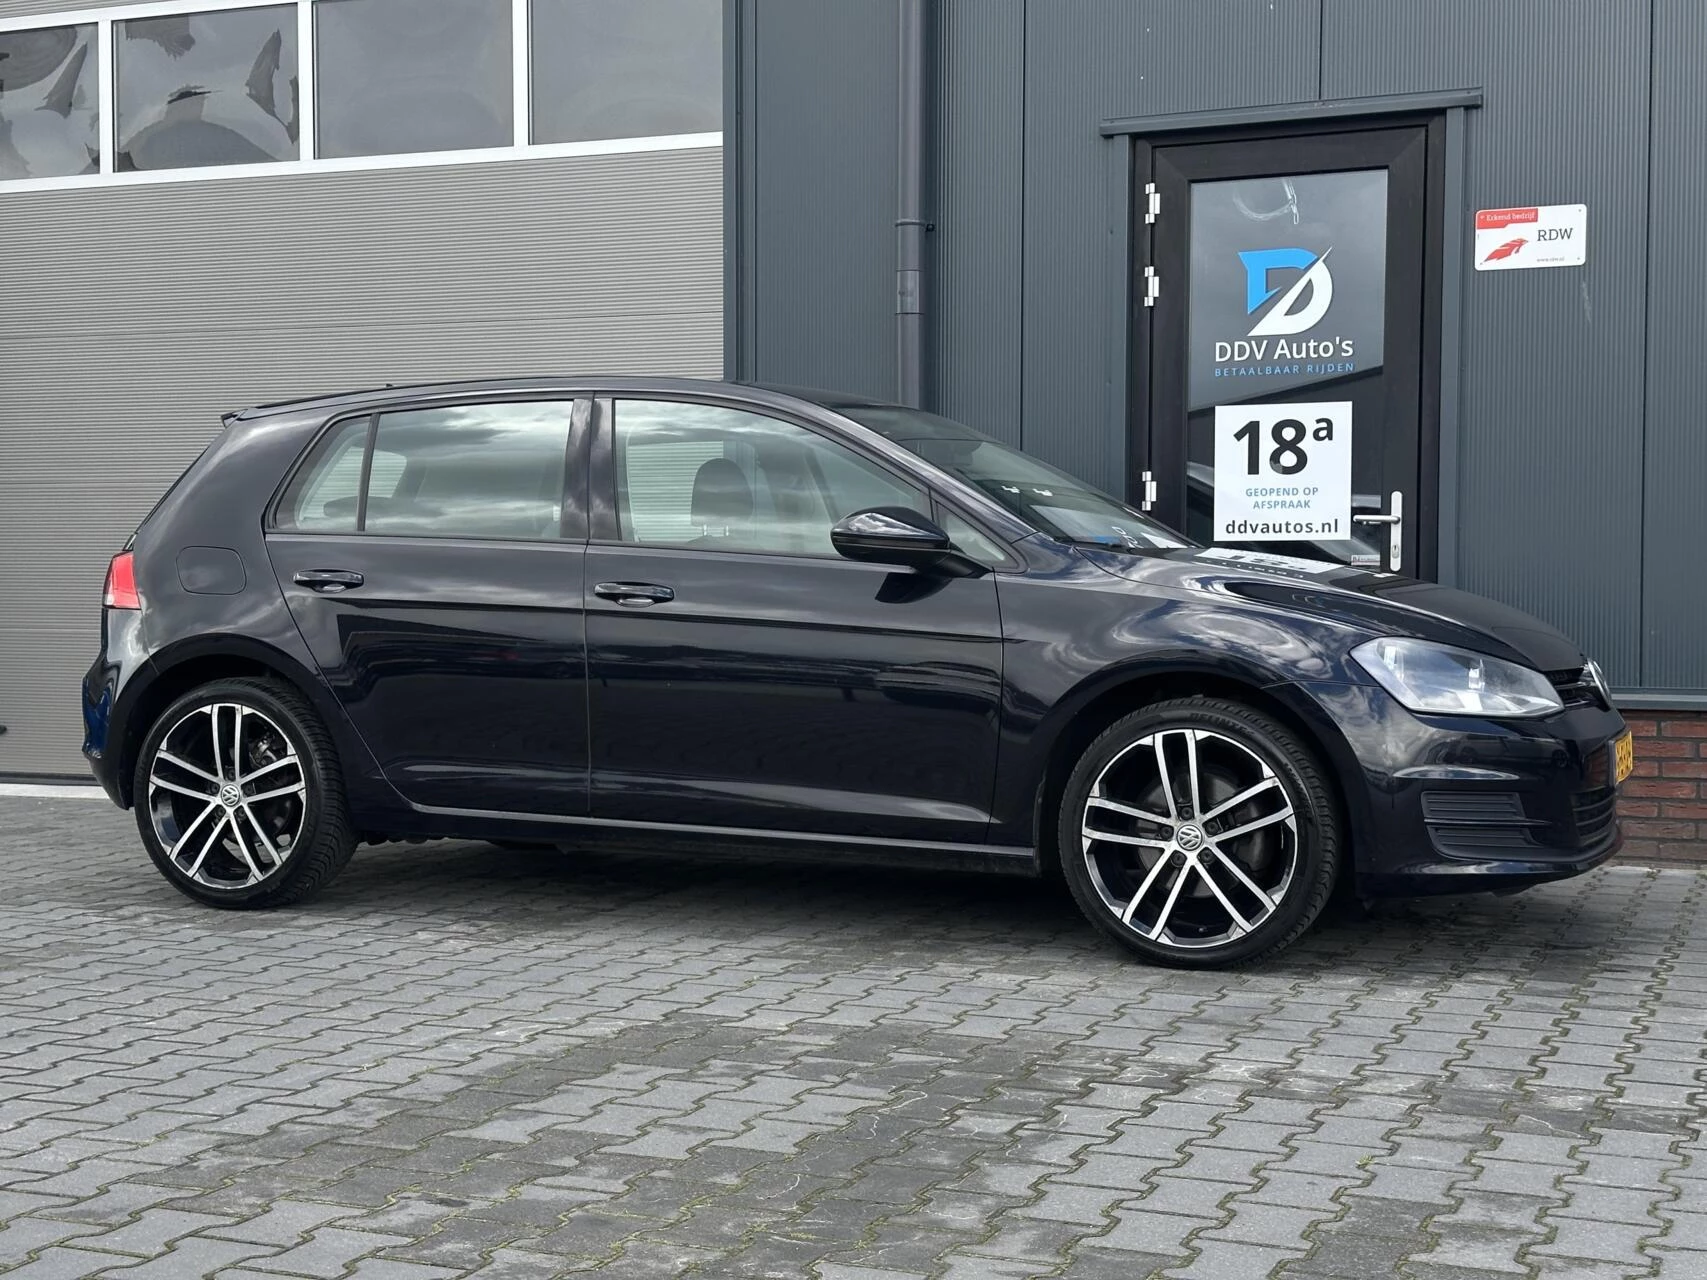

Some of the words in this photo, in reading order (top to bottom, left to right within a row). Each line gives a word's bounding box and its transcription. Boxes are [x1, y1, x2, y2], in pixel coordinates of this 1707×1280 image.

[1537, 227, 1573, 242] RDW
[1215, 340, 1268, 361] DDV
[1273, 336, 1354, 360] Auto's
[1215, 365, 1299, 377] BETAALBAAR
[1307, 363, 1354, 374] RIJDEN
[1245, 487, 1299, 497] GEOPEND
[1303, 487, 1319, 496] OP
[1253, 500, 1311, 510] AFSPRAAK
[1225, 519, 1339, 534] ddvautos.nl
